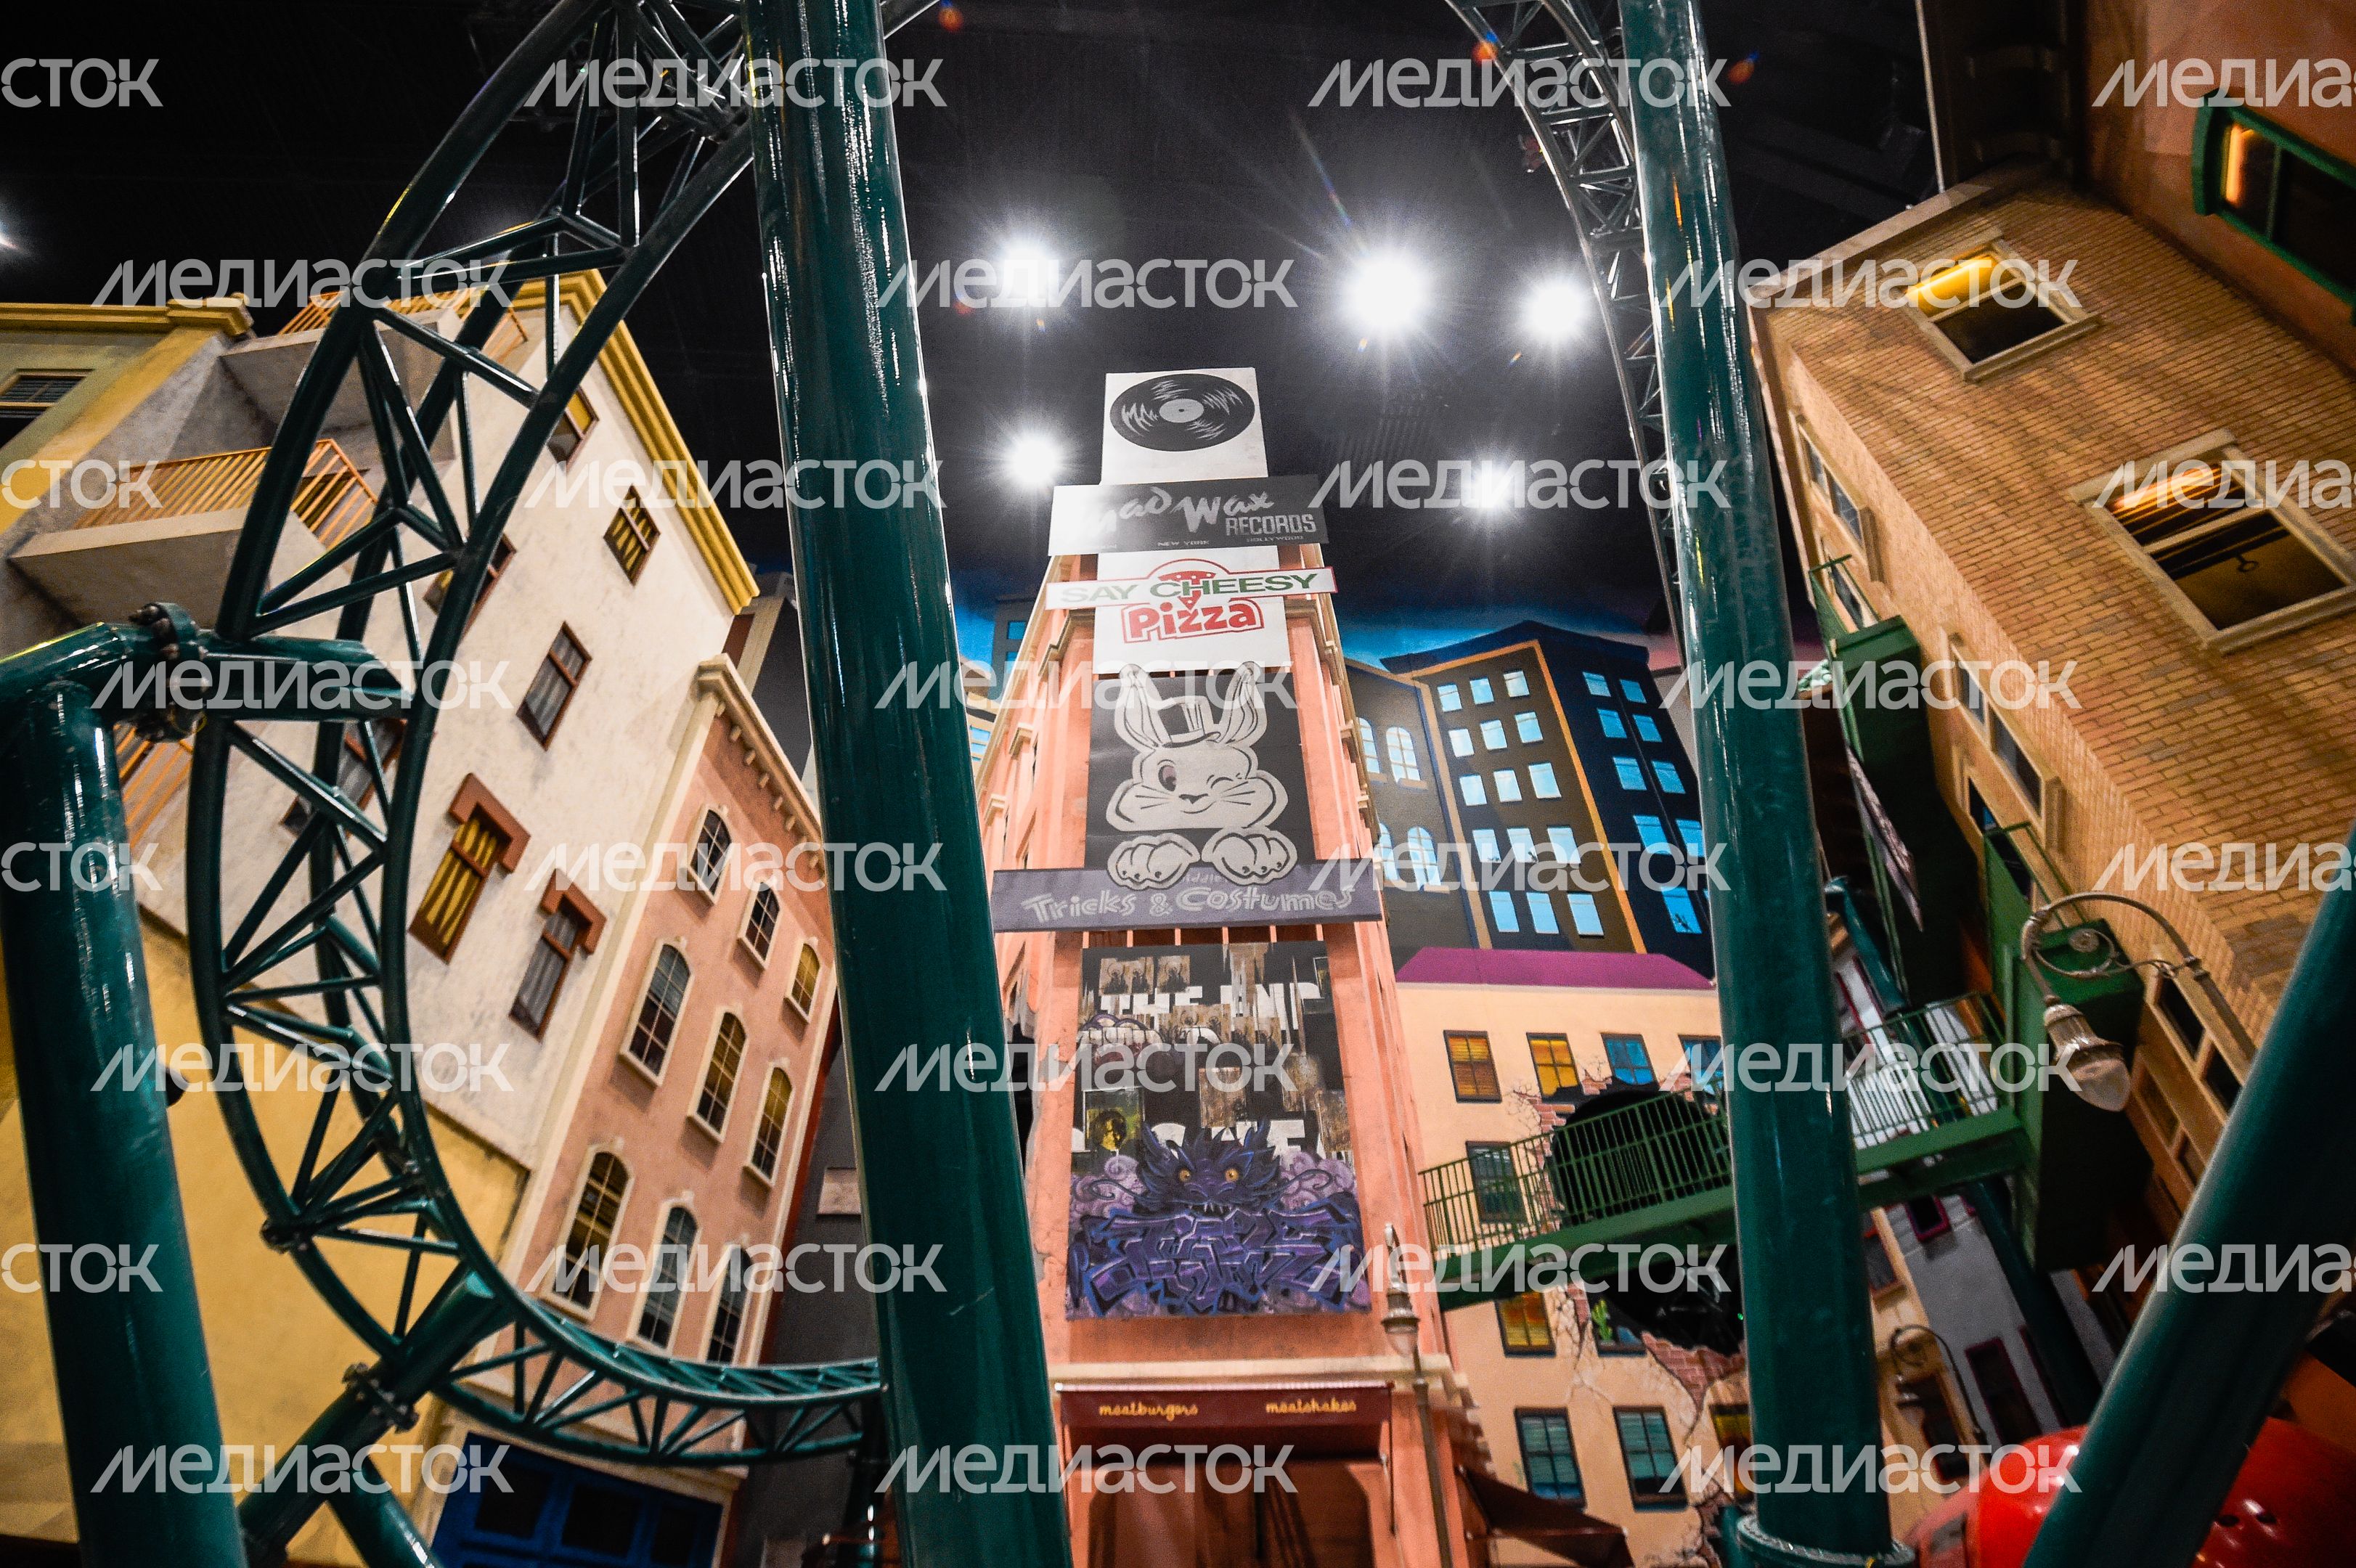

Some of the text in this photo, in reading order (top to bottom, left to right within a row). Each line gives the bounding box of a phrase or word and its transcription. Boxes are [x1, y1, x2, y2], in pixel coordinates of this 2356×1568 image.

[1226, 513, 1317, 536] RECORDS
[1061, 573, 1318, 603] SAY CHEESY
[1128, 601, 1258, 639] Pizza
[1020, 885, 1356, 923] Tricks & Costumes
